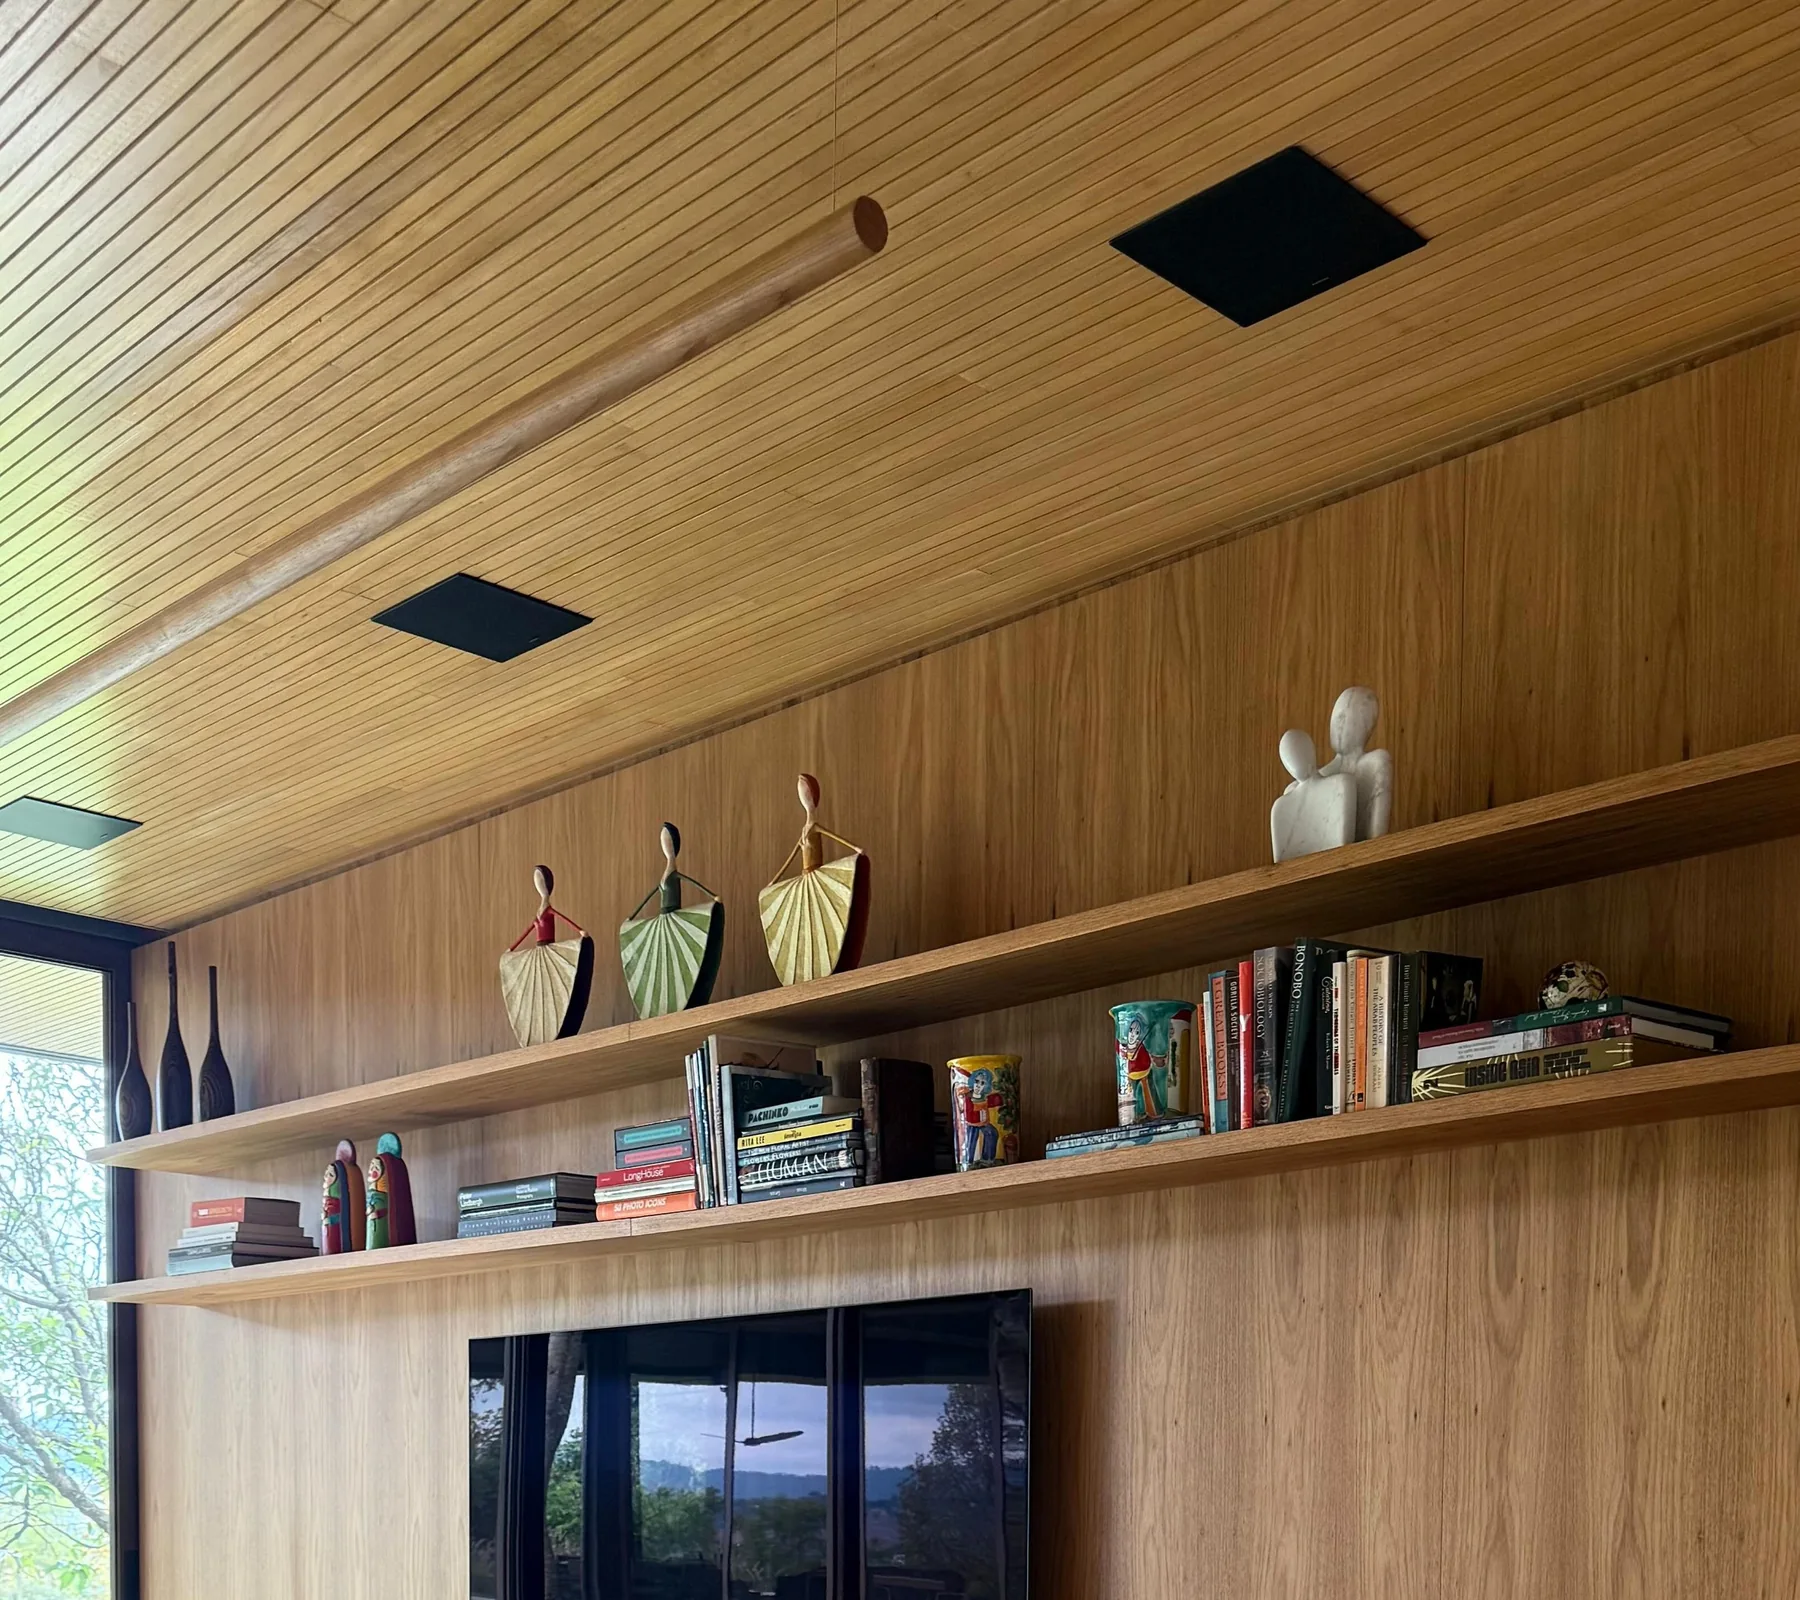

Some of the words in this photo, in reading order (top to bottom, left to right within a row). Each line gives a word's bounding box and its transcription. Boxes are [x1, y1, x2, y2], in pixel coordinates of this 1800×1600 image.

[1292, 945, 1306, 999] BONOBO
[1229, 981, 1238, 1010] GORILLA
[1256, 956, 1265, 1040] SOCIOBIOLOGY
[1215, 988, 1224, 1033] GREAT
[1230, 1012, 1238, 1040] SOCIETY
[1216, 1044, 1226, 1085] BOOKS
[748, 1106, 788, 1124] PACHINKO
[741, 1137, 754, 1148] RITA
[755, 1135, 765, 1145] LEE
[792, 1140, 810, 1149] ARTIST
[623, 1168, 664, 1182] LongHouse
[756, 1153, 828, 1182] HUMAN
[623, 1201, 645, 1211] PHOTO
[645, 1198, 666, 1208] ICONS
